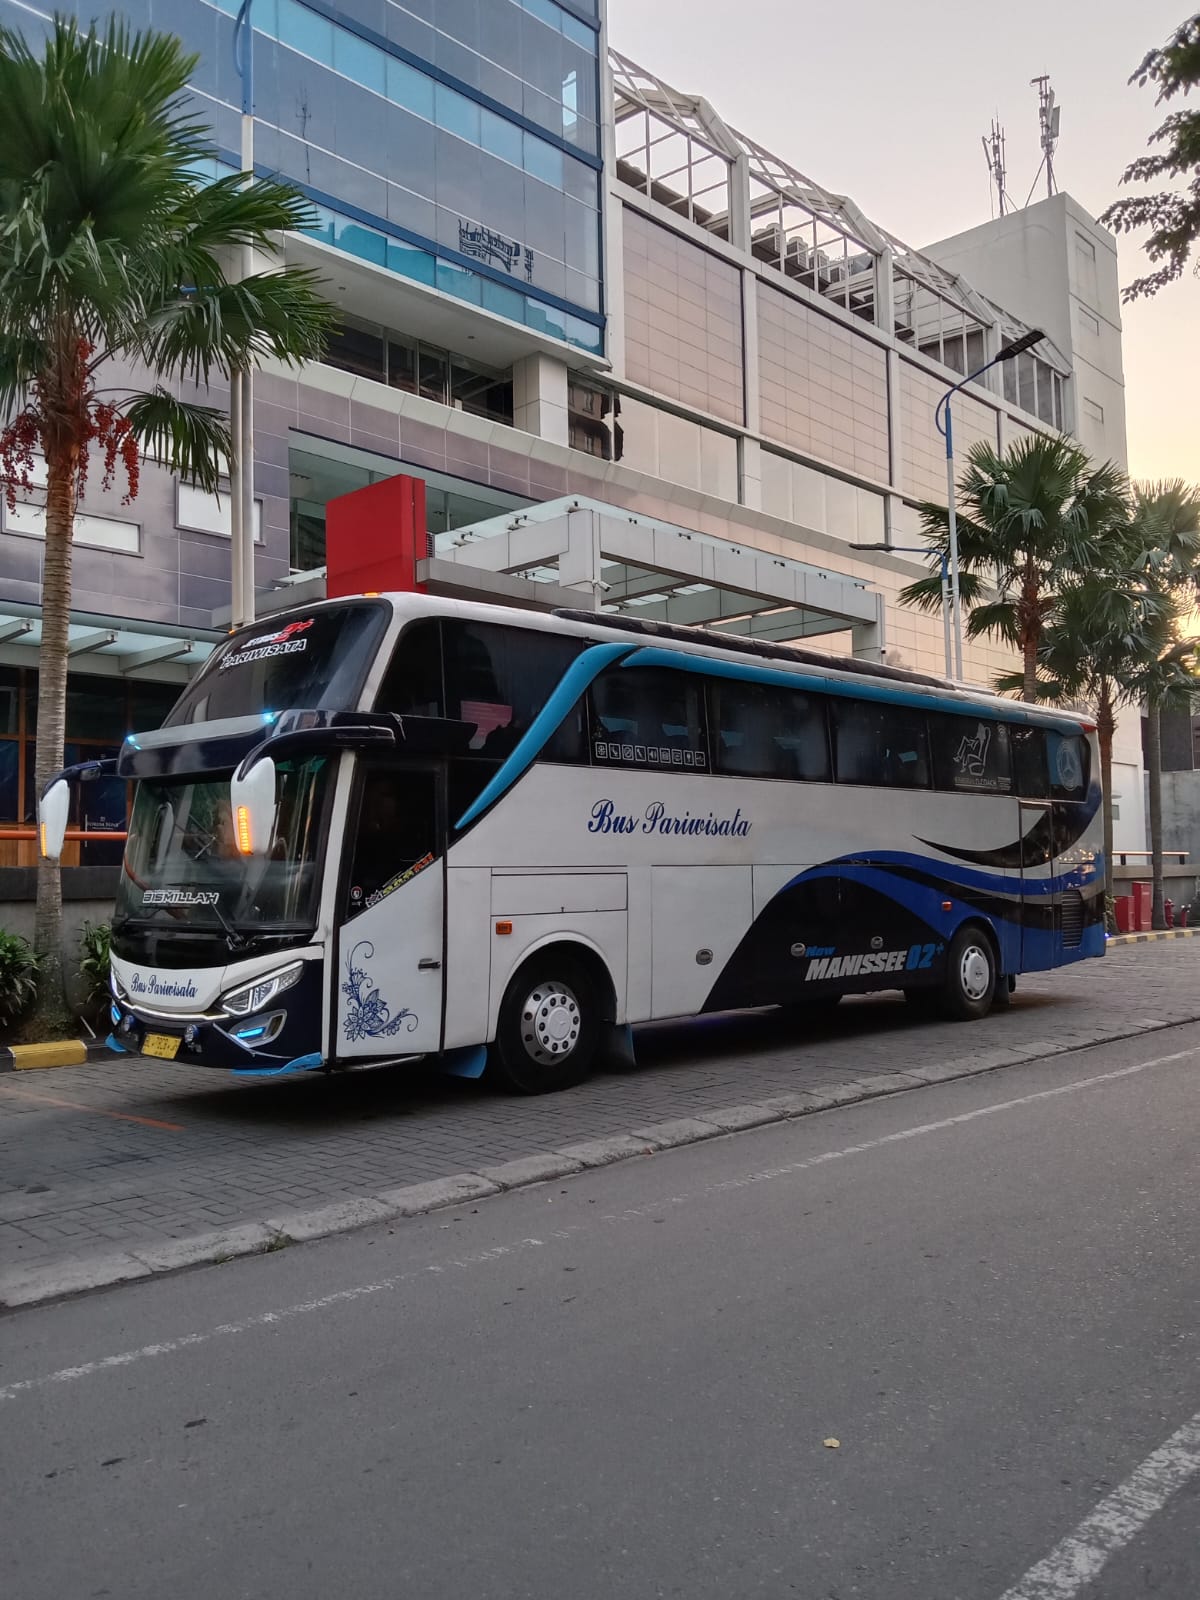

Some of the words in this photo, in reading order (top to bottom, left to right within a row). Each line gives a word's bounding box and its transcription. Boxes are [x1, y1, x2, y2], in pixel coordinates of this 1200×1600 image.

[219, 638, 308, 670] PARIWISATA
[587, 799, 640, 834] Bus
[642, 801, 752, 837] Pariwisata
[142, 891, 220, 905] BISMILLAH
[804, 950, 909, 982] MANISSEE
[130, 972, 148, 993] Bus
[147, 974, 199, 998] Pariwisata
